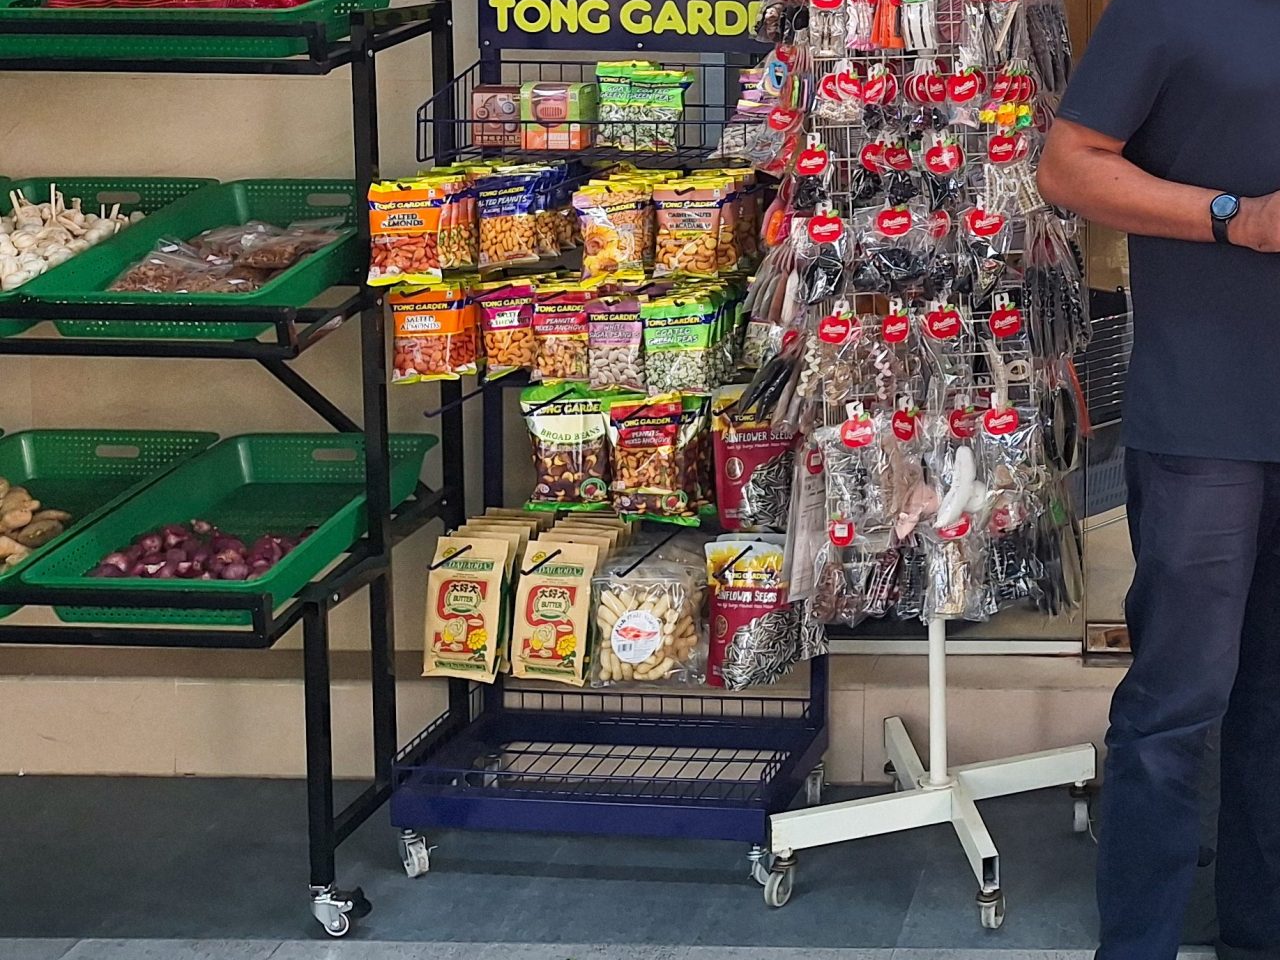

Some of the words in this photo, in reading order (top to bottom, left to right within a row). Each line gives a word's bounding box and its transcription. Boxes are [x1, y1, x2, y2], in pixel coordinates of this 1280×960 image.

[498, 194, 528, 205] PEANUTS
[396, 201, 434, 209] GARDEN
[660, 201, 683, 209] TONG
[387, 213, 418, 221] SALTED
[393, 304, 415, 312] TONG
[415, 302, 449, 311] GARDEN
[481, 300, 503, 308] TONG
[535, 305, 557, 313] TONG
[406, 315, 435, 323] SALTED
[589, 313, 609, 321] TONG
[608, 313, 640, 321] GARDEN
[646, 319, 667, 328] TONG
[667, 316, 701, 325] GARDEN
[676, 335, 699, 344] PEAS
[622, 418, 641, 428] ONG
[640, 417, 672, 426] GARDEN
[540, 428, 572, 441] BROAD
[573, 426, 601, 439] BEANS
[724, 430, 768, 443] SUNFLOWER
[770, 430, 793, 441] SEEDS
[450, 583, 479, 595] 大好大
[539, 588, 568, 600] 大好大
[452, 595, 474, 603] BUTTER
[540, 601, 563, 609] BUTTER
